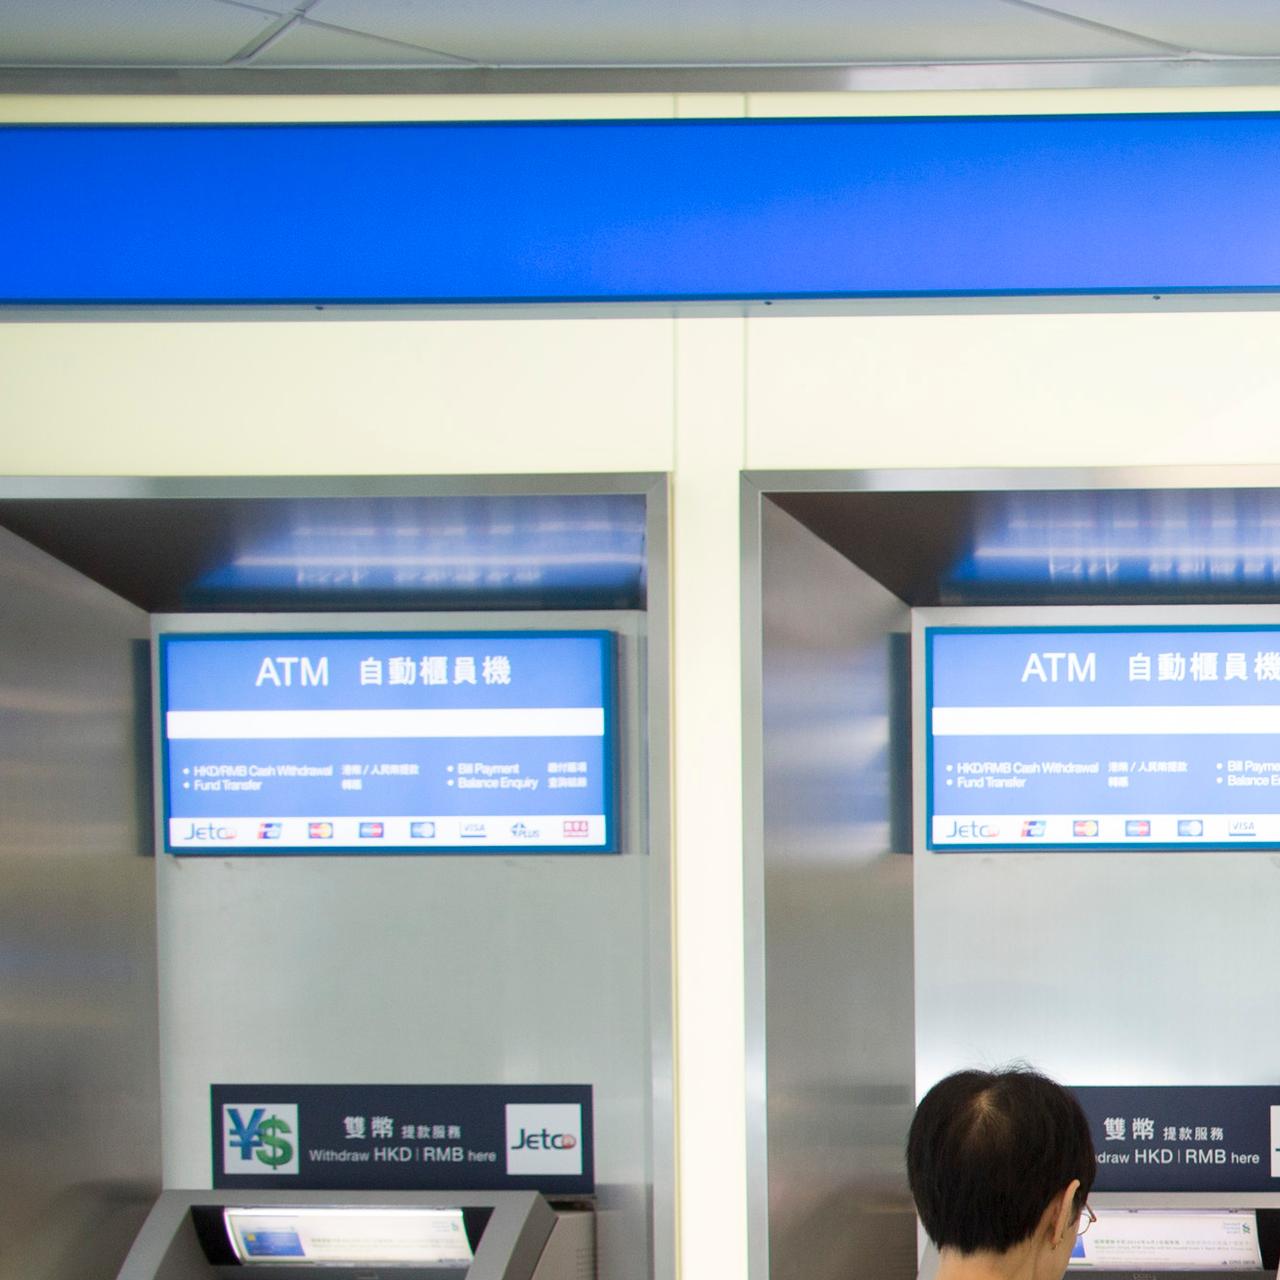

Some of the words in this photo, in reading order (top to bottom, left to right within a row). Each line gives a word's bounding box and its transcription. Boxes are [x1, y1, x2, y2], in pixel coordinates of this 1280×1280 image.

[256, 657, 329, 687] ATM
[360, 655, 511, 686] 自動櫃員機
[1021, 653, 1096, 682] ATM
[249, 765, 276, 776] Cash
[277, 765, 333, 776] Withdrawal
[457, 763, 473, 774] Bill
[474, 763, 520, 776] Payment
[1013, 762, 1040, 774] Cash
[1042, 762, 1099, 774] Withdrawal
[1227, 760, 1244, 771] Bill
[194, 779, 220, 790] Fund
[222, 779, 263, 790] Transfer
[457, 777, 499, 789] Balance
[500, 777, 539, 791] Enquiry
[957, 777, 984, 789] Fund
[986, 777, 1026, 789] Transfer
[1227, 775, 1269, 786] Balance
[511, 1129, 577, 1151] Jetco
[309, 1149, 370, 1163] Withdraw
[374, 1147, 411, 1162] HKD
[424, 1147, 464, 1162] RMB
[468, 1151, 497, 1163] here
[1135, 1149, 1173, 1164] HKD
[1185, 1149, 1226, 1164] RMB
[1232, 1152, 1260, 1164] here
